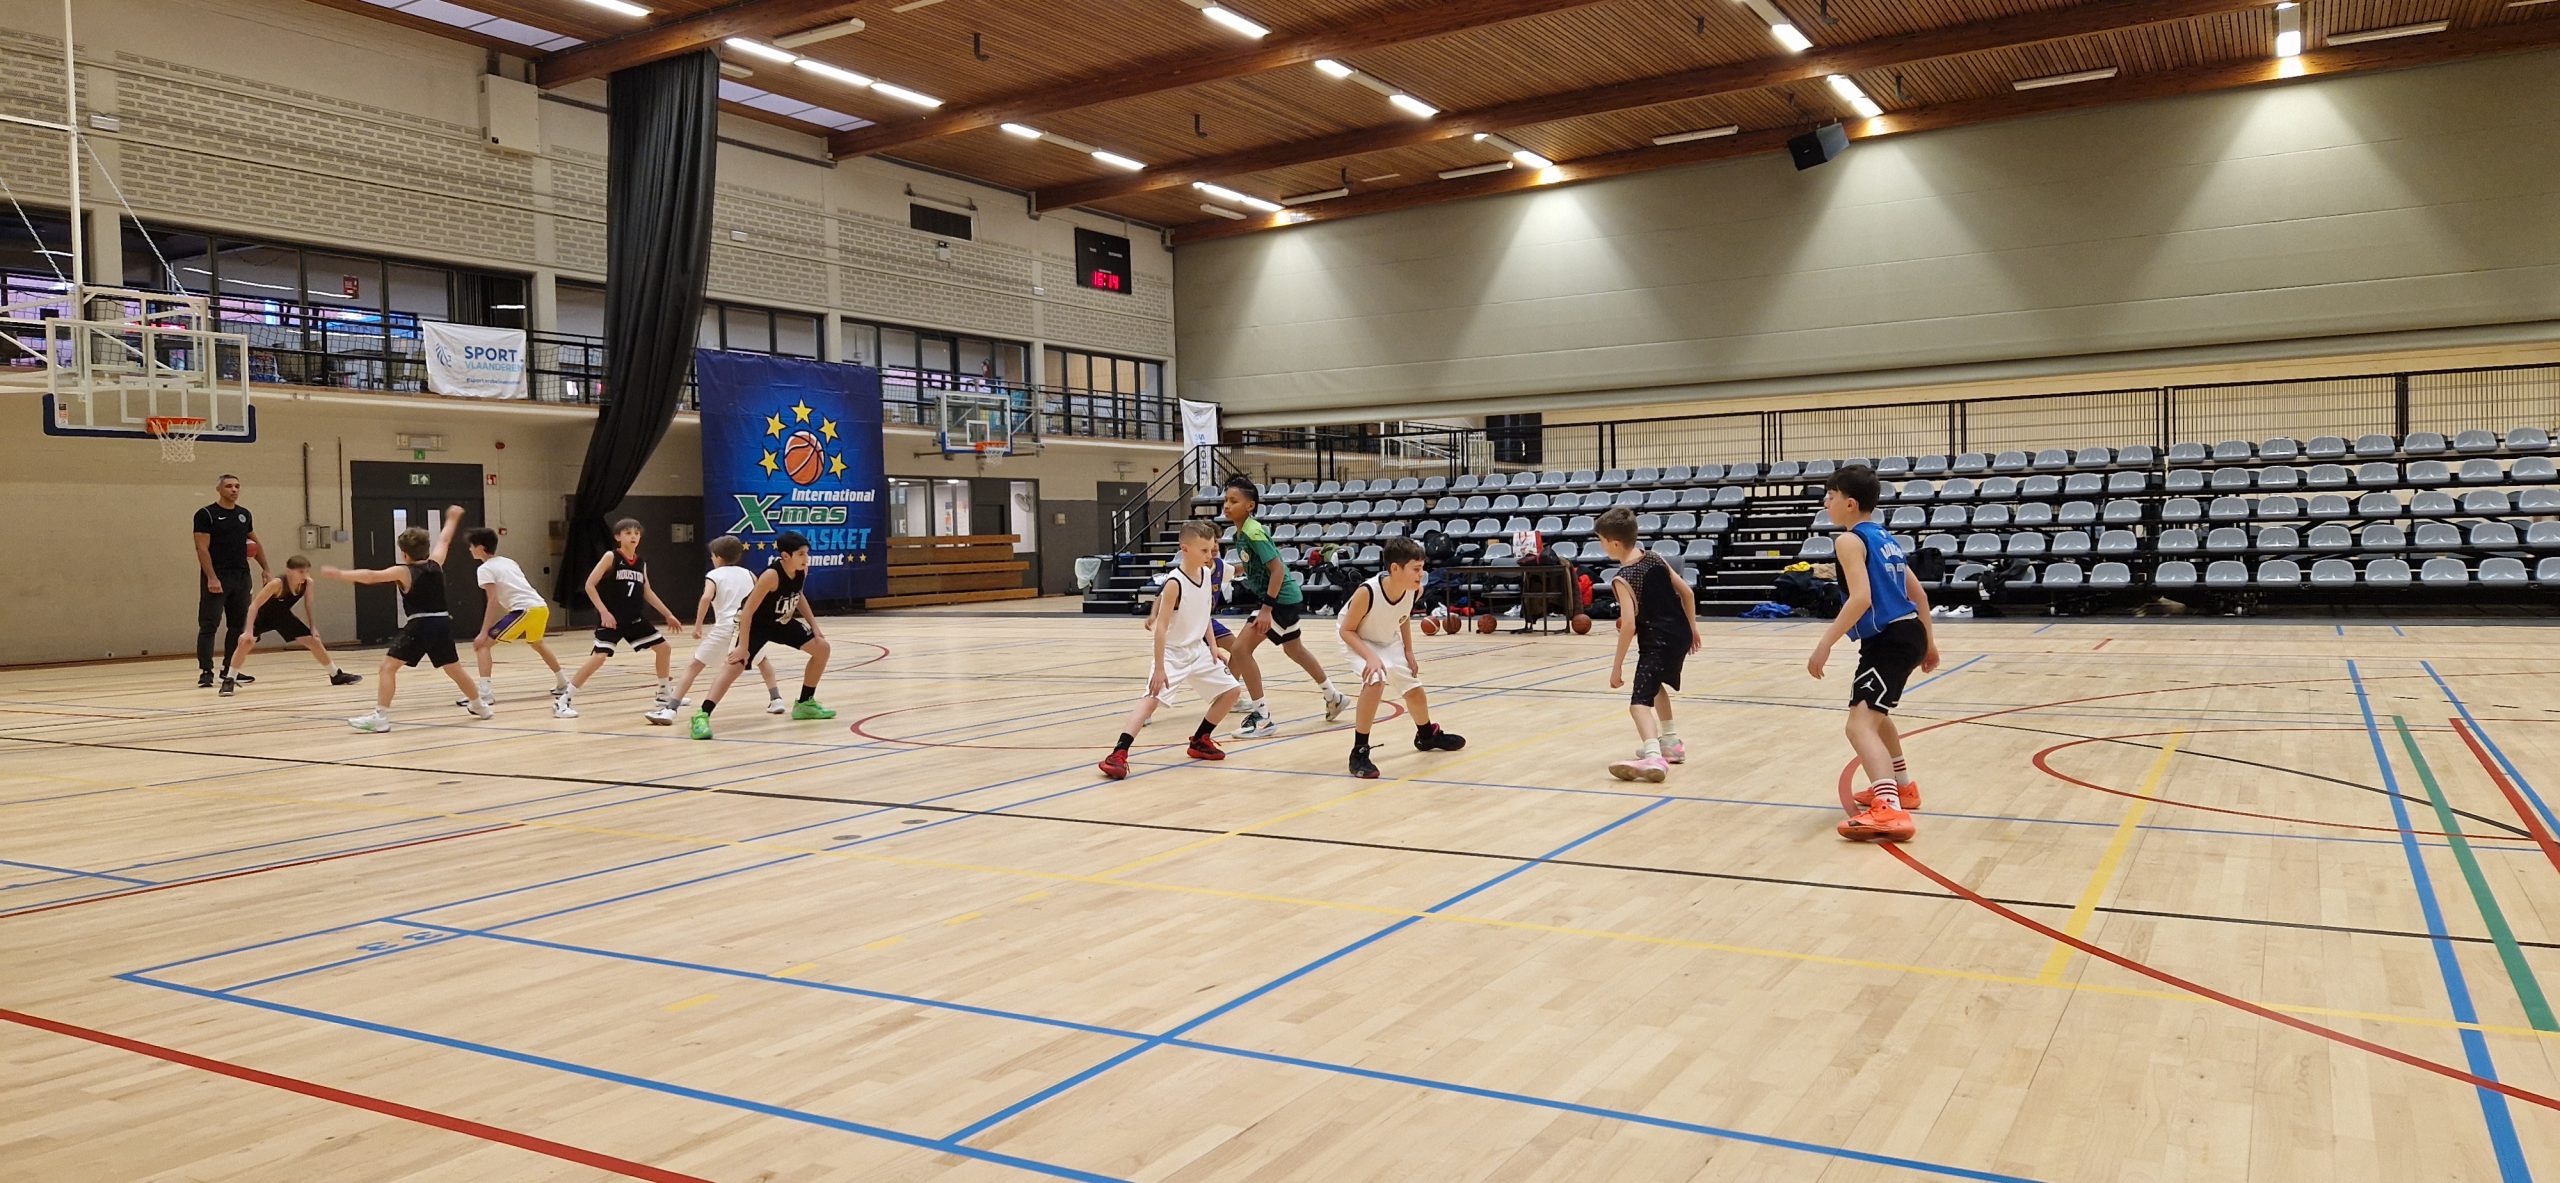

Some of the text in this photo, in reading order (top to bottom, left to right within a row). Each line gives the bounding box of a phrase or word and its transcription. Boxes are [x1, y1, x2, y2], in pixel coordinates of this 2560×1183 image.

[465, 361, 524, 373] VLAANDEREN
[791, 487, 876, 503] International
[725, 494, 848, 534] X-mas
[792, 528, 871, 551] ASKET
[627, 581, 635, 598] 7
